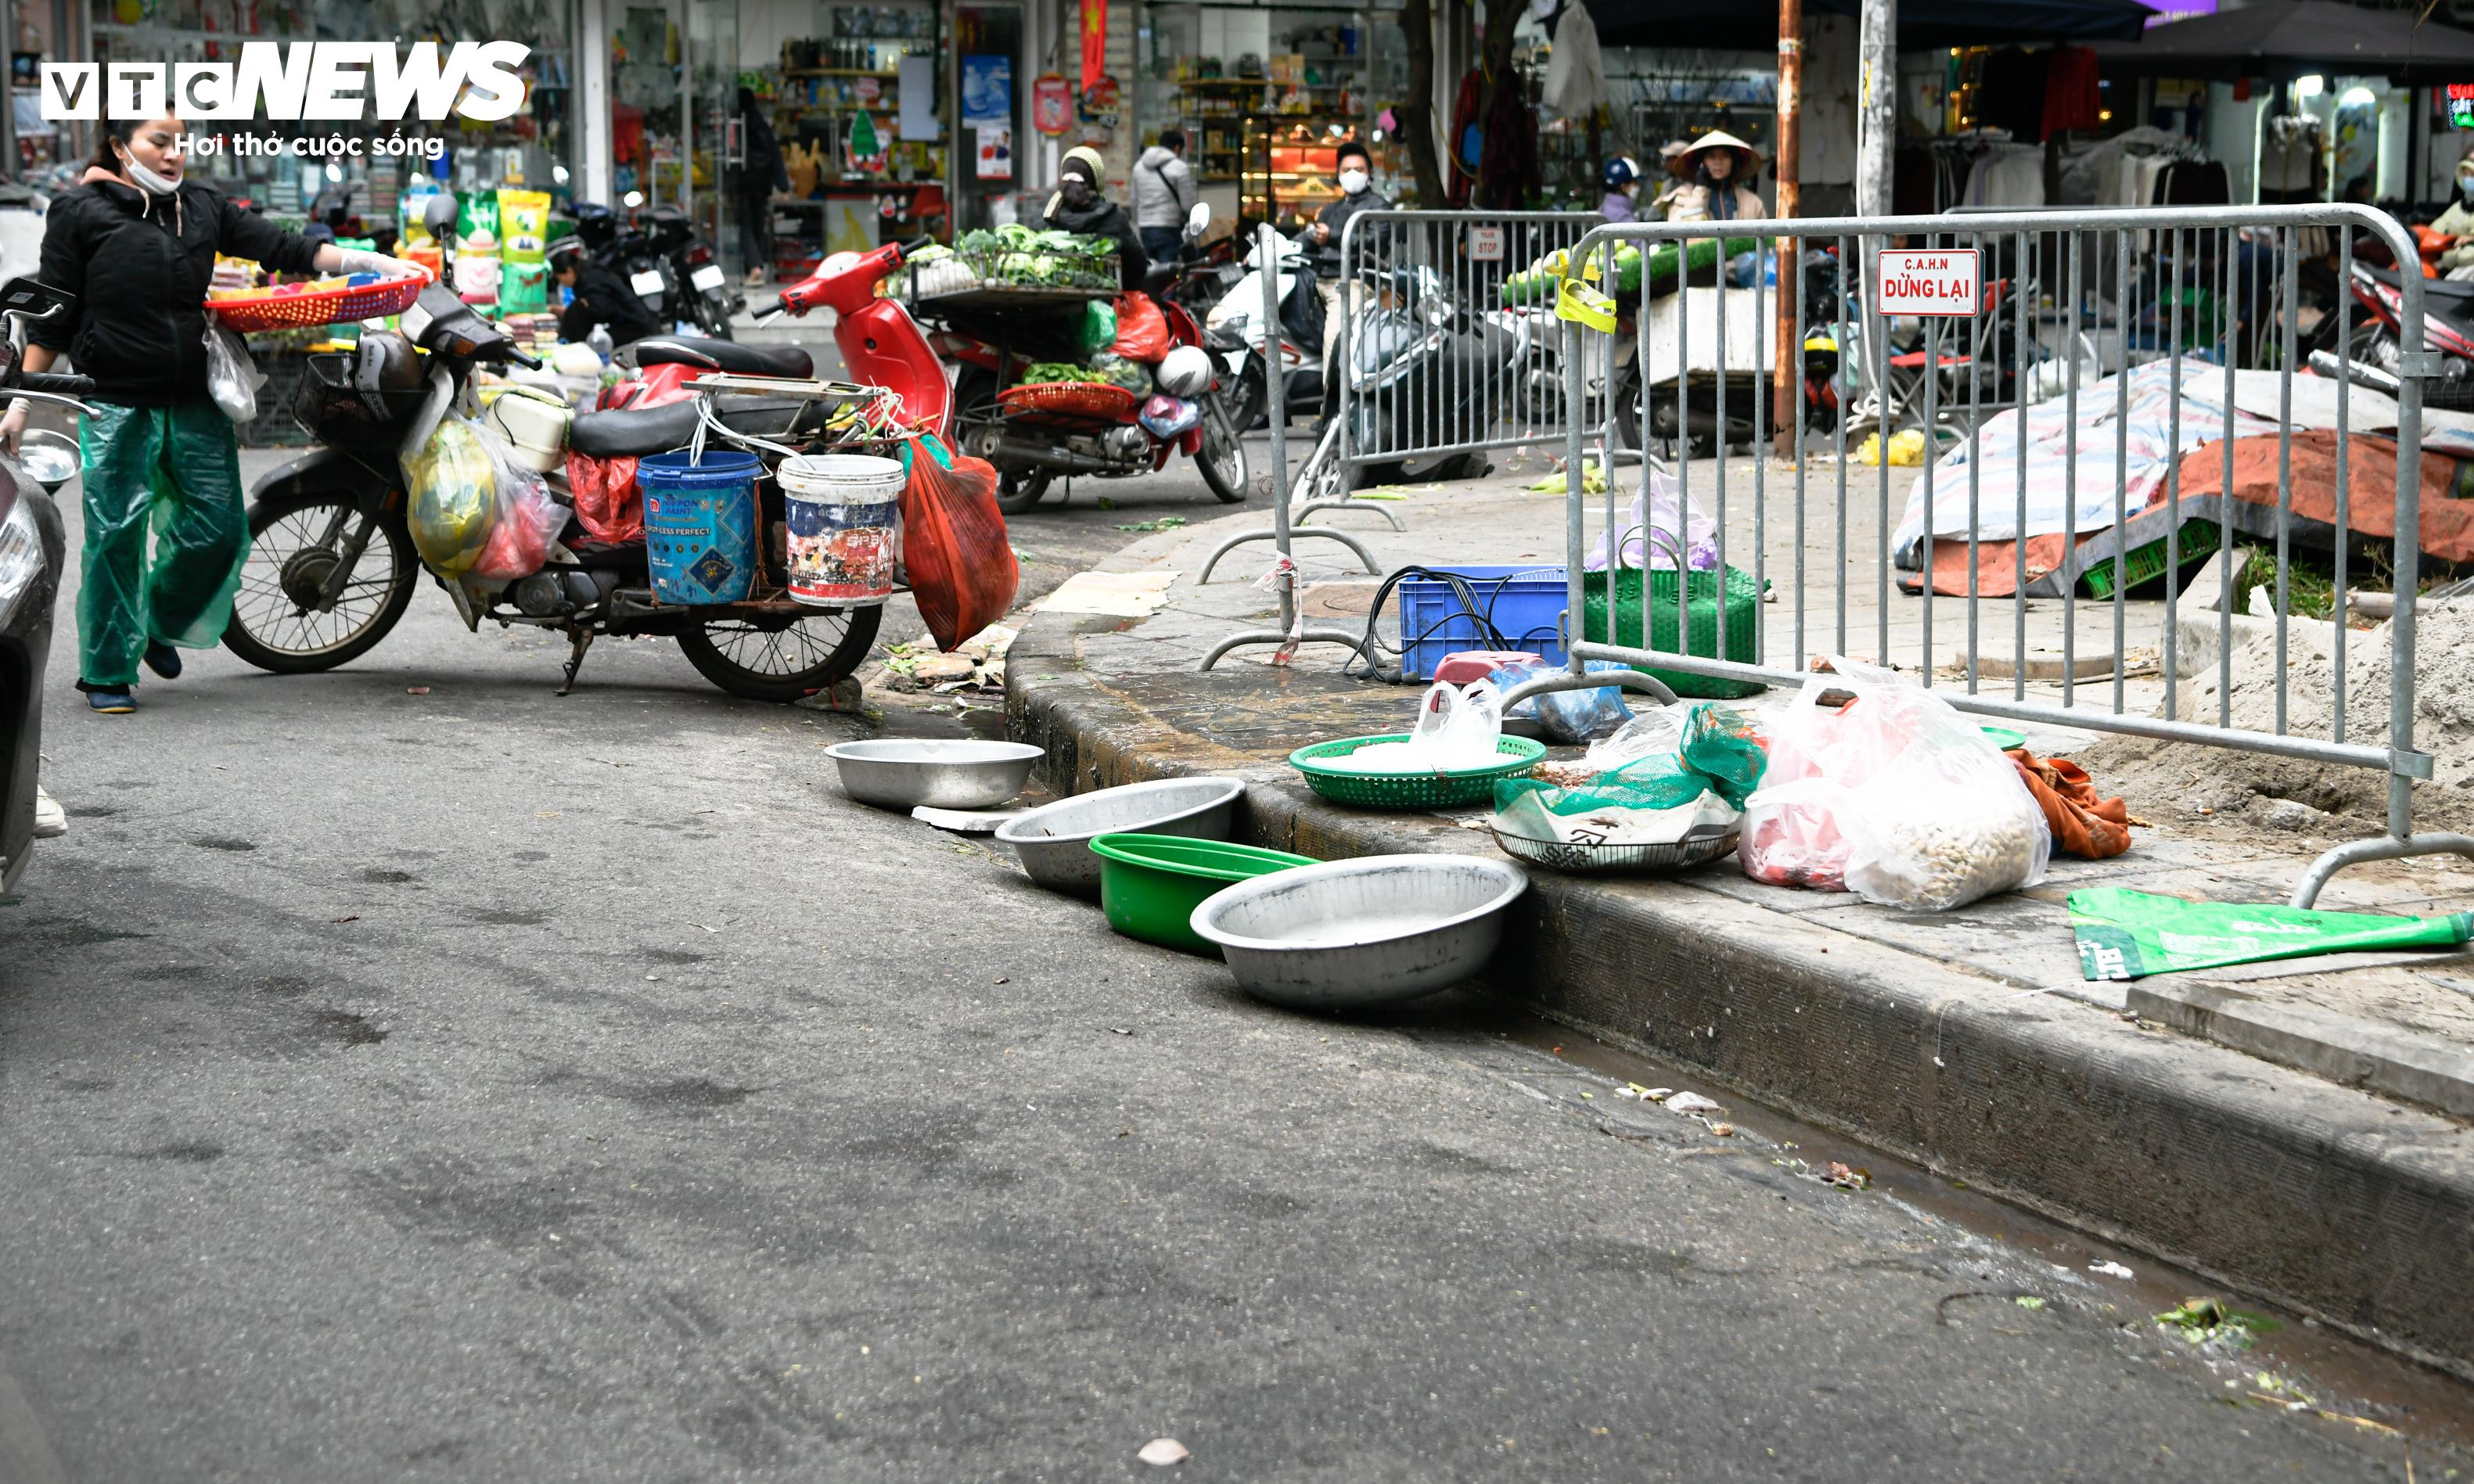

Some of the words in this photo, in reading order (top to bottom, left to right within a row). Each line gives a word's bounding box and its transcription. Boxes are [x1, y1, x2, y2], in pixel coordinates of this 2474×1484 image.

[1478, 243, 1497, 253] STOP
[1905, 258, 1948, 270] C.A.H.N
[1885, 272, 1934, 297] DỪNG
[1939, 279, 1969, 303] LẠI
[676, 527, 711, 536] PERFECT
